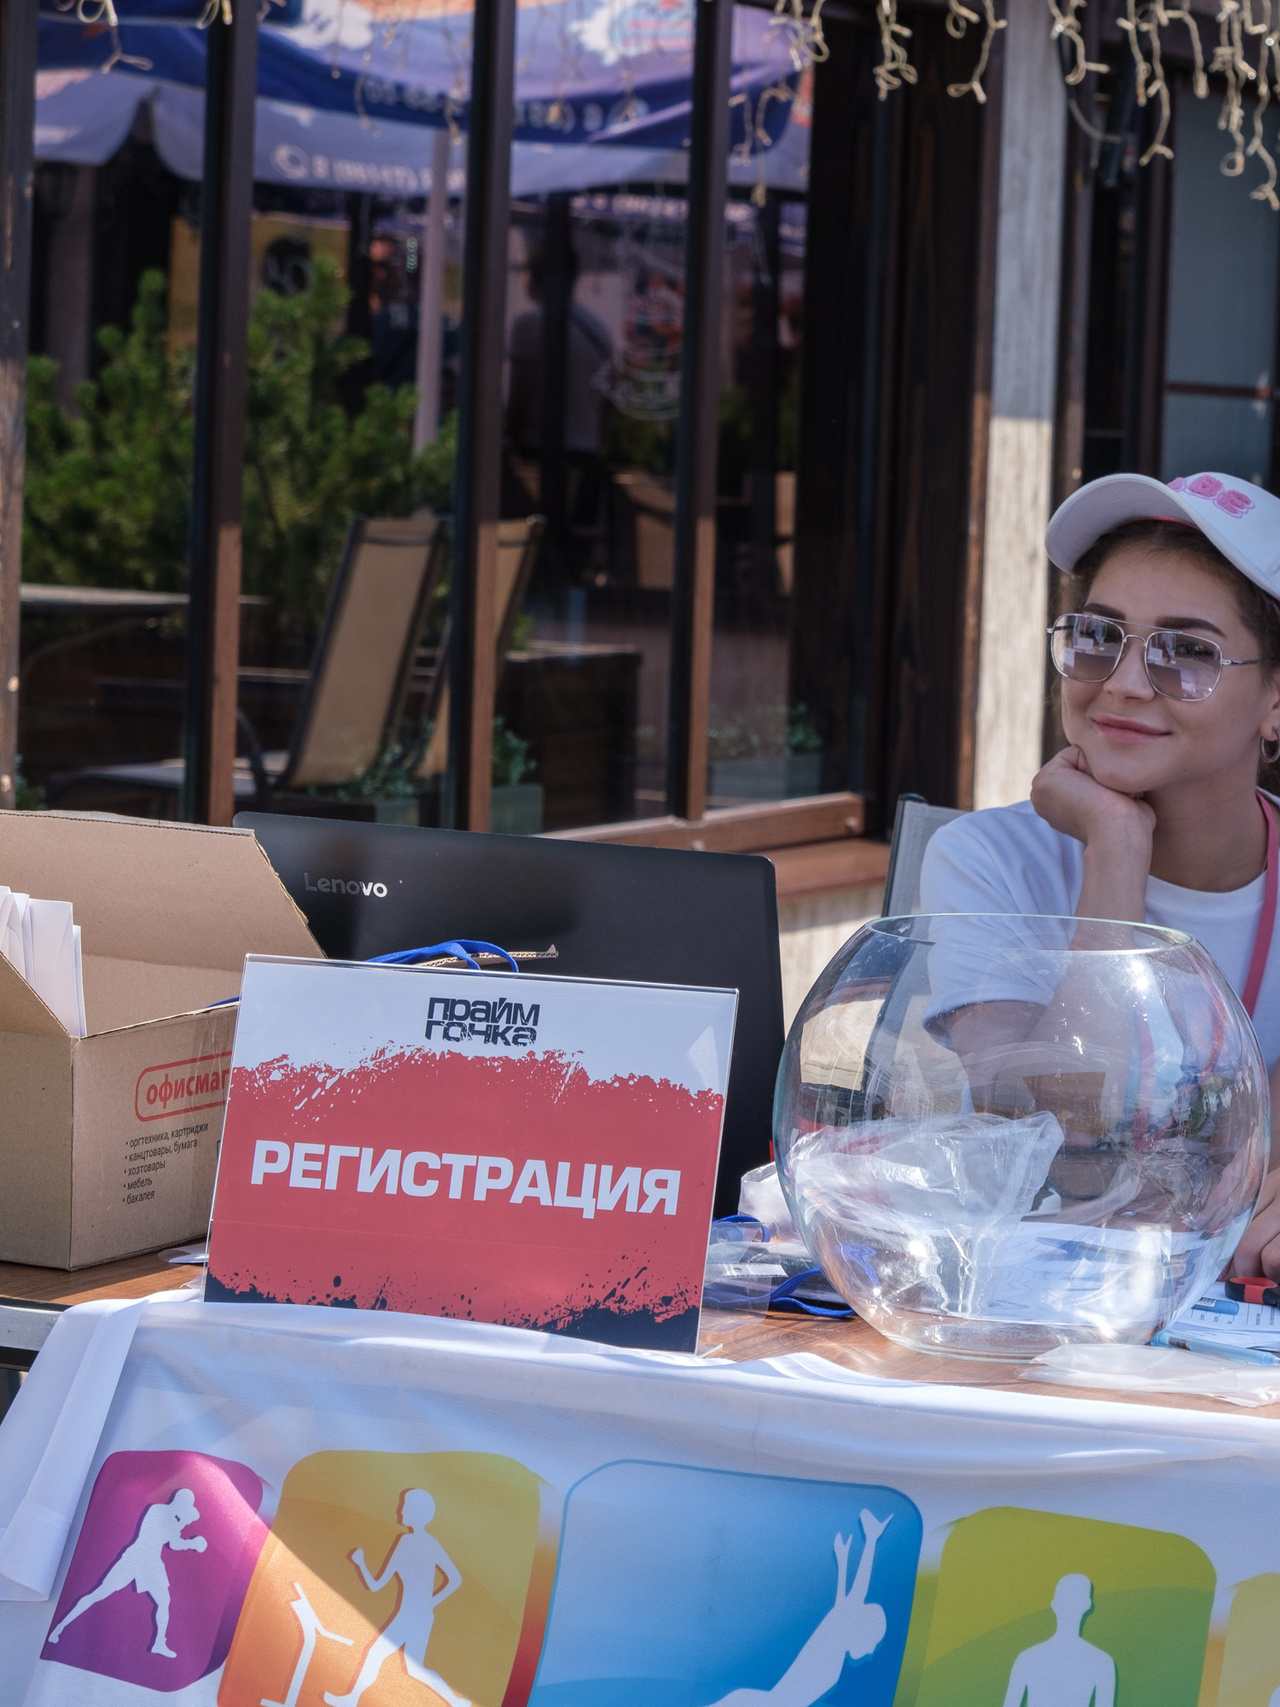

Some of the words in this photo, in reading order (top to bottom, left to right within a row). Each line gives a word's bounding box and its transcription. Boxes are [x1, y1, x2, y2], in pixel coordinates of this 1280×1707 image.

[304, 872, 388, 898] Lenovo
[129, 1130, 170, 1149] оргтехника,
[170, 1123, 209, 1140] картриджи
[128, 1145, 173, 1162] канцтовары,
[173, 1138, 198, 1154] бумага
[128, 1160, 166, 1176] хозтовары
[251, 1140, 681, 1219] РЕГИСТРАЦИЯ
[127, 1176, 153, 1190] мебель
[126, 1190, 155, 1205] бакалея
